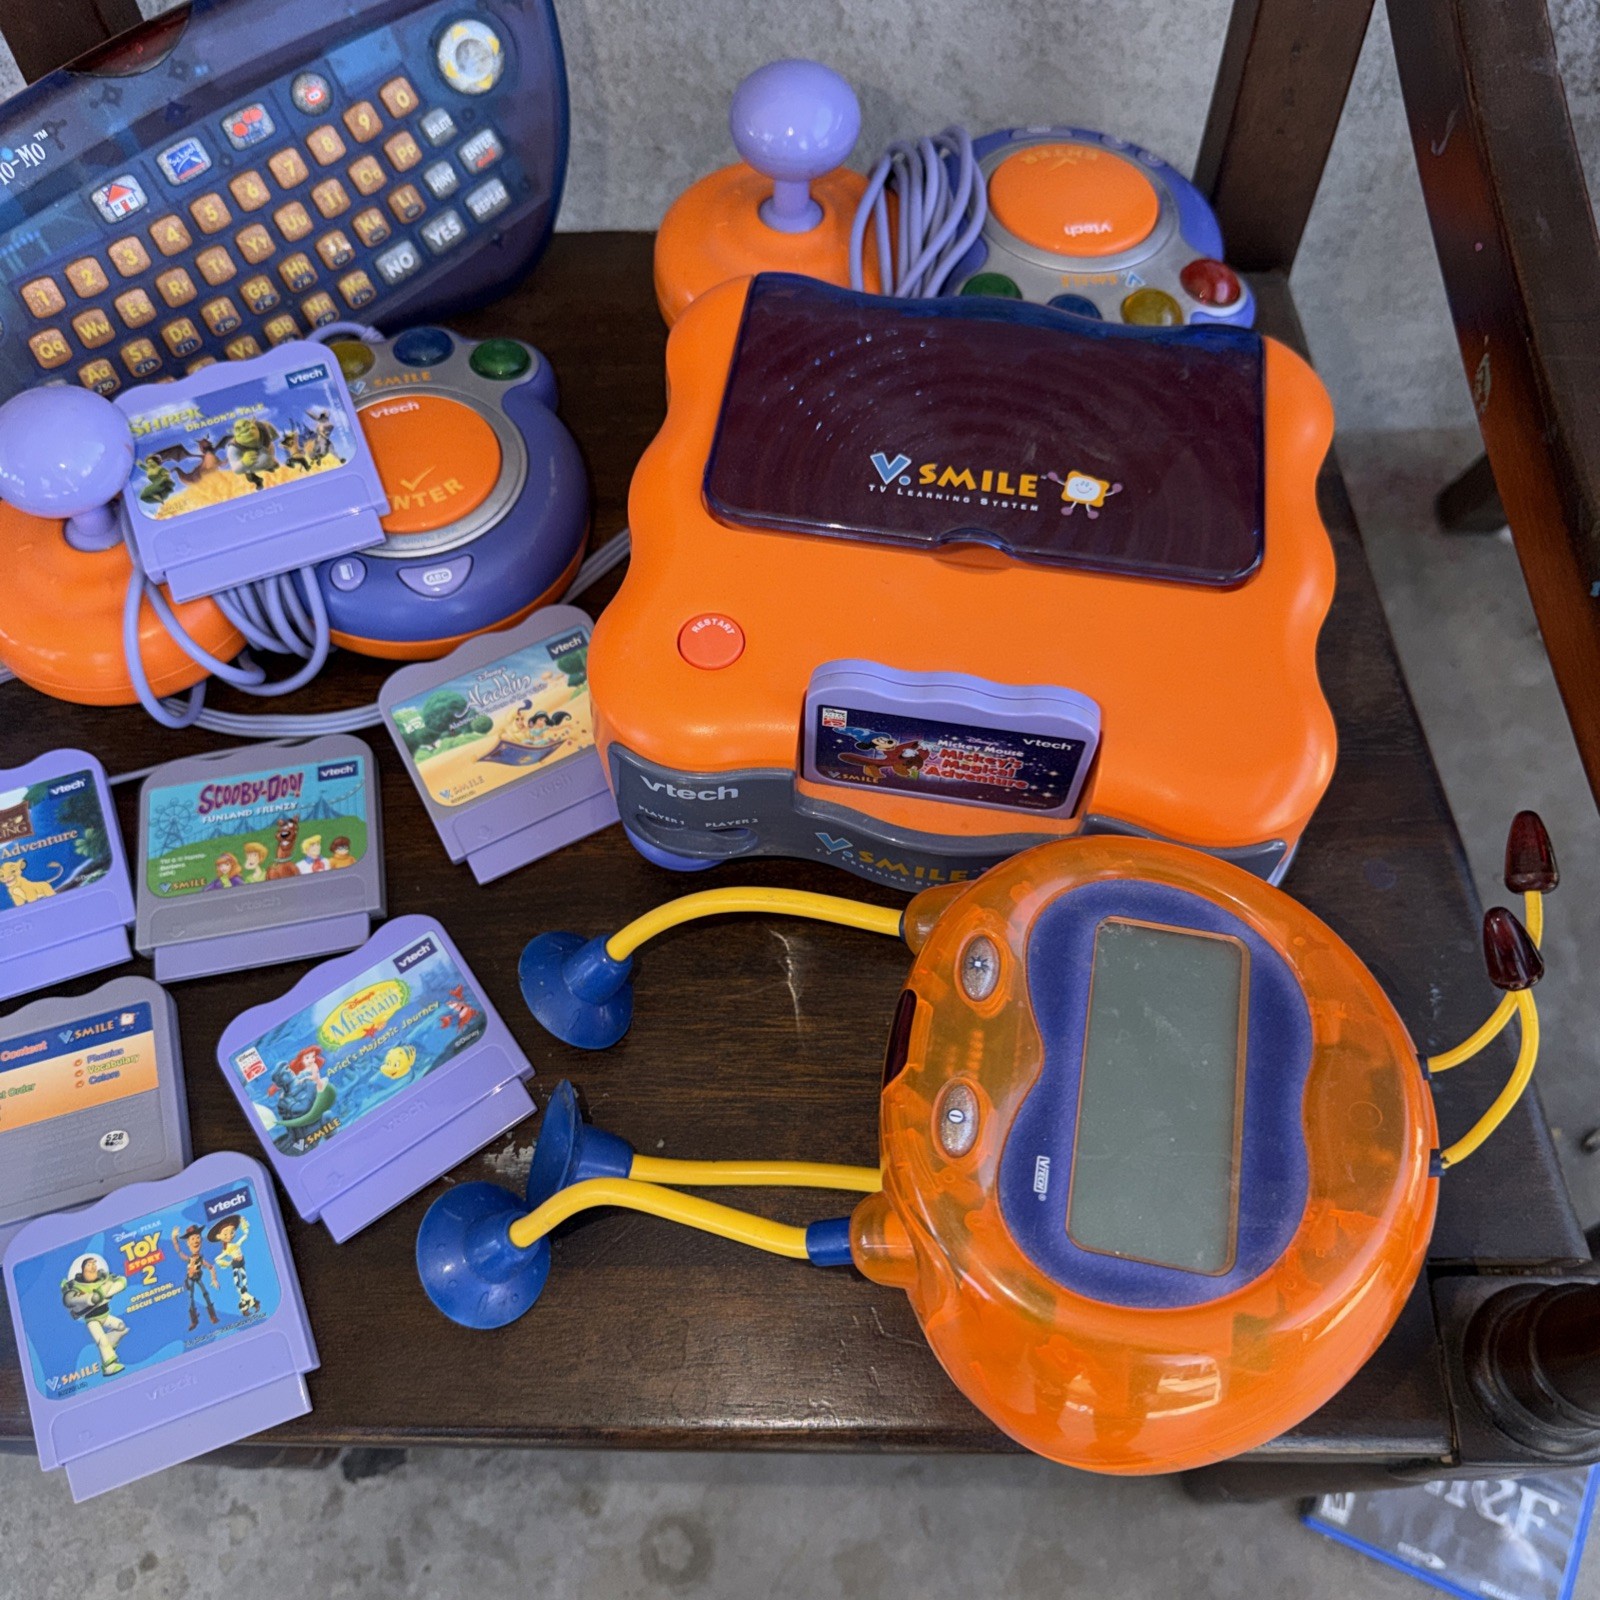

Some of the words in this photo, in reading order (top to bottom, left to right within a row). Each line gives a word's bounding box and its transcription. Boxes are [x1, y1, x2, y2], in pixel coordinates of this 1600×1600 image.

[358, 114, 370, 131] 9
[321, 135, 335, 152] 8
[464, 133, 497, 161] ENTER
[283, 160, 296, 178] 7
[247, 180, 260, 198] 6
[204, 203, 218, 221] 5
[166, 226, 181, 243] 4
[428, 218, 462, 248] YES
[1064, 221, 1113, 237] vtech
[123, 249, 138, 266] 3
[386, 253, 415, 278] NO
[80, 269, 95, 286] 2
[37, 289, 50, 307] 1
[289, 369, 324, 385] vtech
[370, 401, 420, 419] vtech
[389, 478, 465, 511] NTER
[868, 483, 888, 493] TV
[426, 571, 450, 583] ABC
[691, 617, 735, 636] RESTART
[551, 637, 582, 656] vtech
[454, 673, 532, 718] Aladdin
[937, 740, 983, 754] Mickey
[984, 745, 1025, 758] Mouse
[1022, 738, 1073, 751] vtech
[940, 748, 1024, 770] Mickey's
[321, 764, 355, 779] vtech
[925, 766, 1029, 790] Adventure
[942, 759, 1016, 779] Magical
[51, 780, 84, 795] vtech
[198, 772, 304, 815] SCOOBY-DOO!
[639, 775, 739, 801] vtech
[202, 808, 254, 825] FUNLAND
[256, 802, 299, 816] FRENZY
[638, 804, 678, 824] PLAYER
[705, 818, 749, 828] PLAYER
[1, 829, 79, 859] Adventure
[398, 942, 430, 968] vtech
[326, 1053, 359, 1077] Ariel's
[359, 1027, 399, 1057] Majestic
[402, 1001, 440, 1030] Journey
[86, 1047, 125, 1064] Phonics
[86, 1054, 140, 1074] Vocabulary
[8, 1082, 36, 1098] Order
[1034, 1156, 1050, 1193] VTECH
[208, 1193, 246, 1216] vtech
[120, 1231, 162, 1262] TOY
[128, 1252, 162, 1270] STORY
[142, 1266, 158, 1286] 2
[126, 1299, 153, 1314] RESCUE
[154, 1286, 184, 1306] WOODY!
